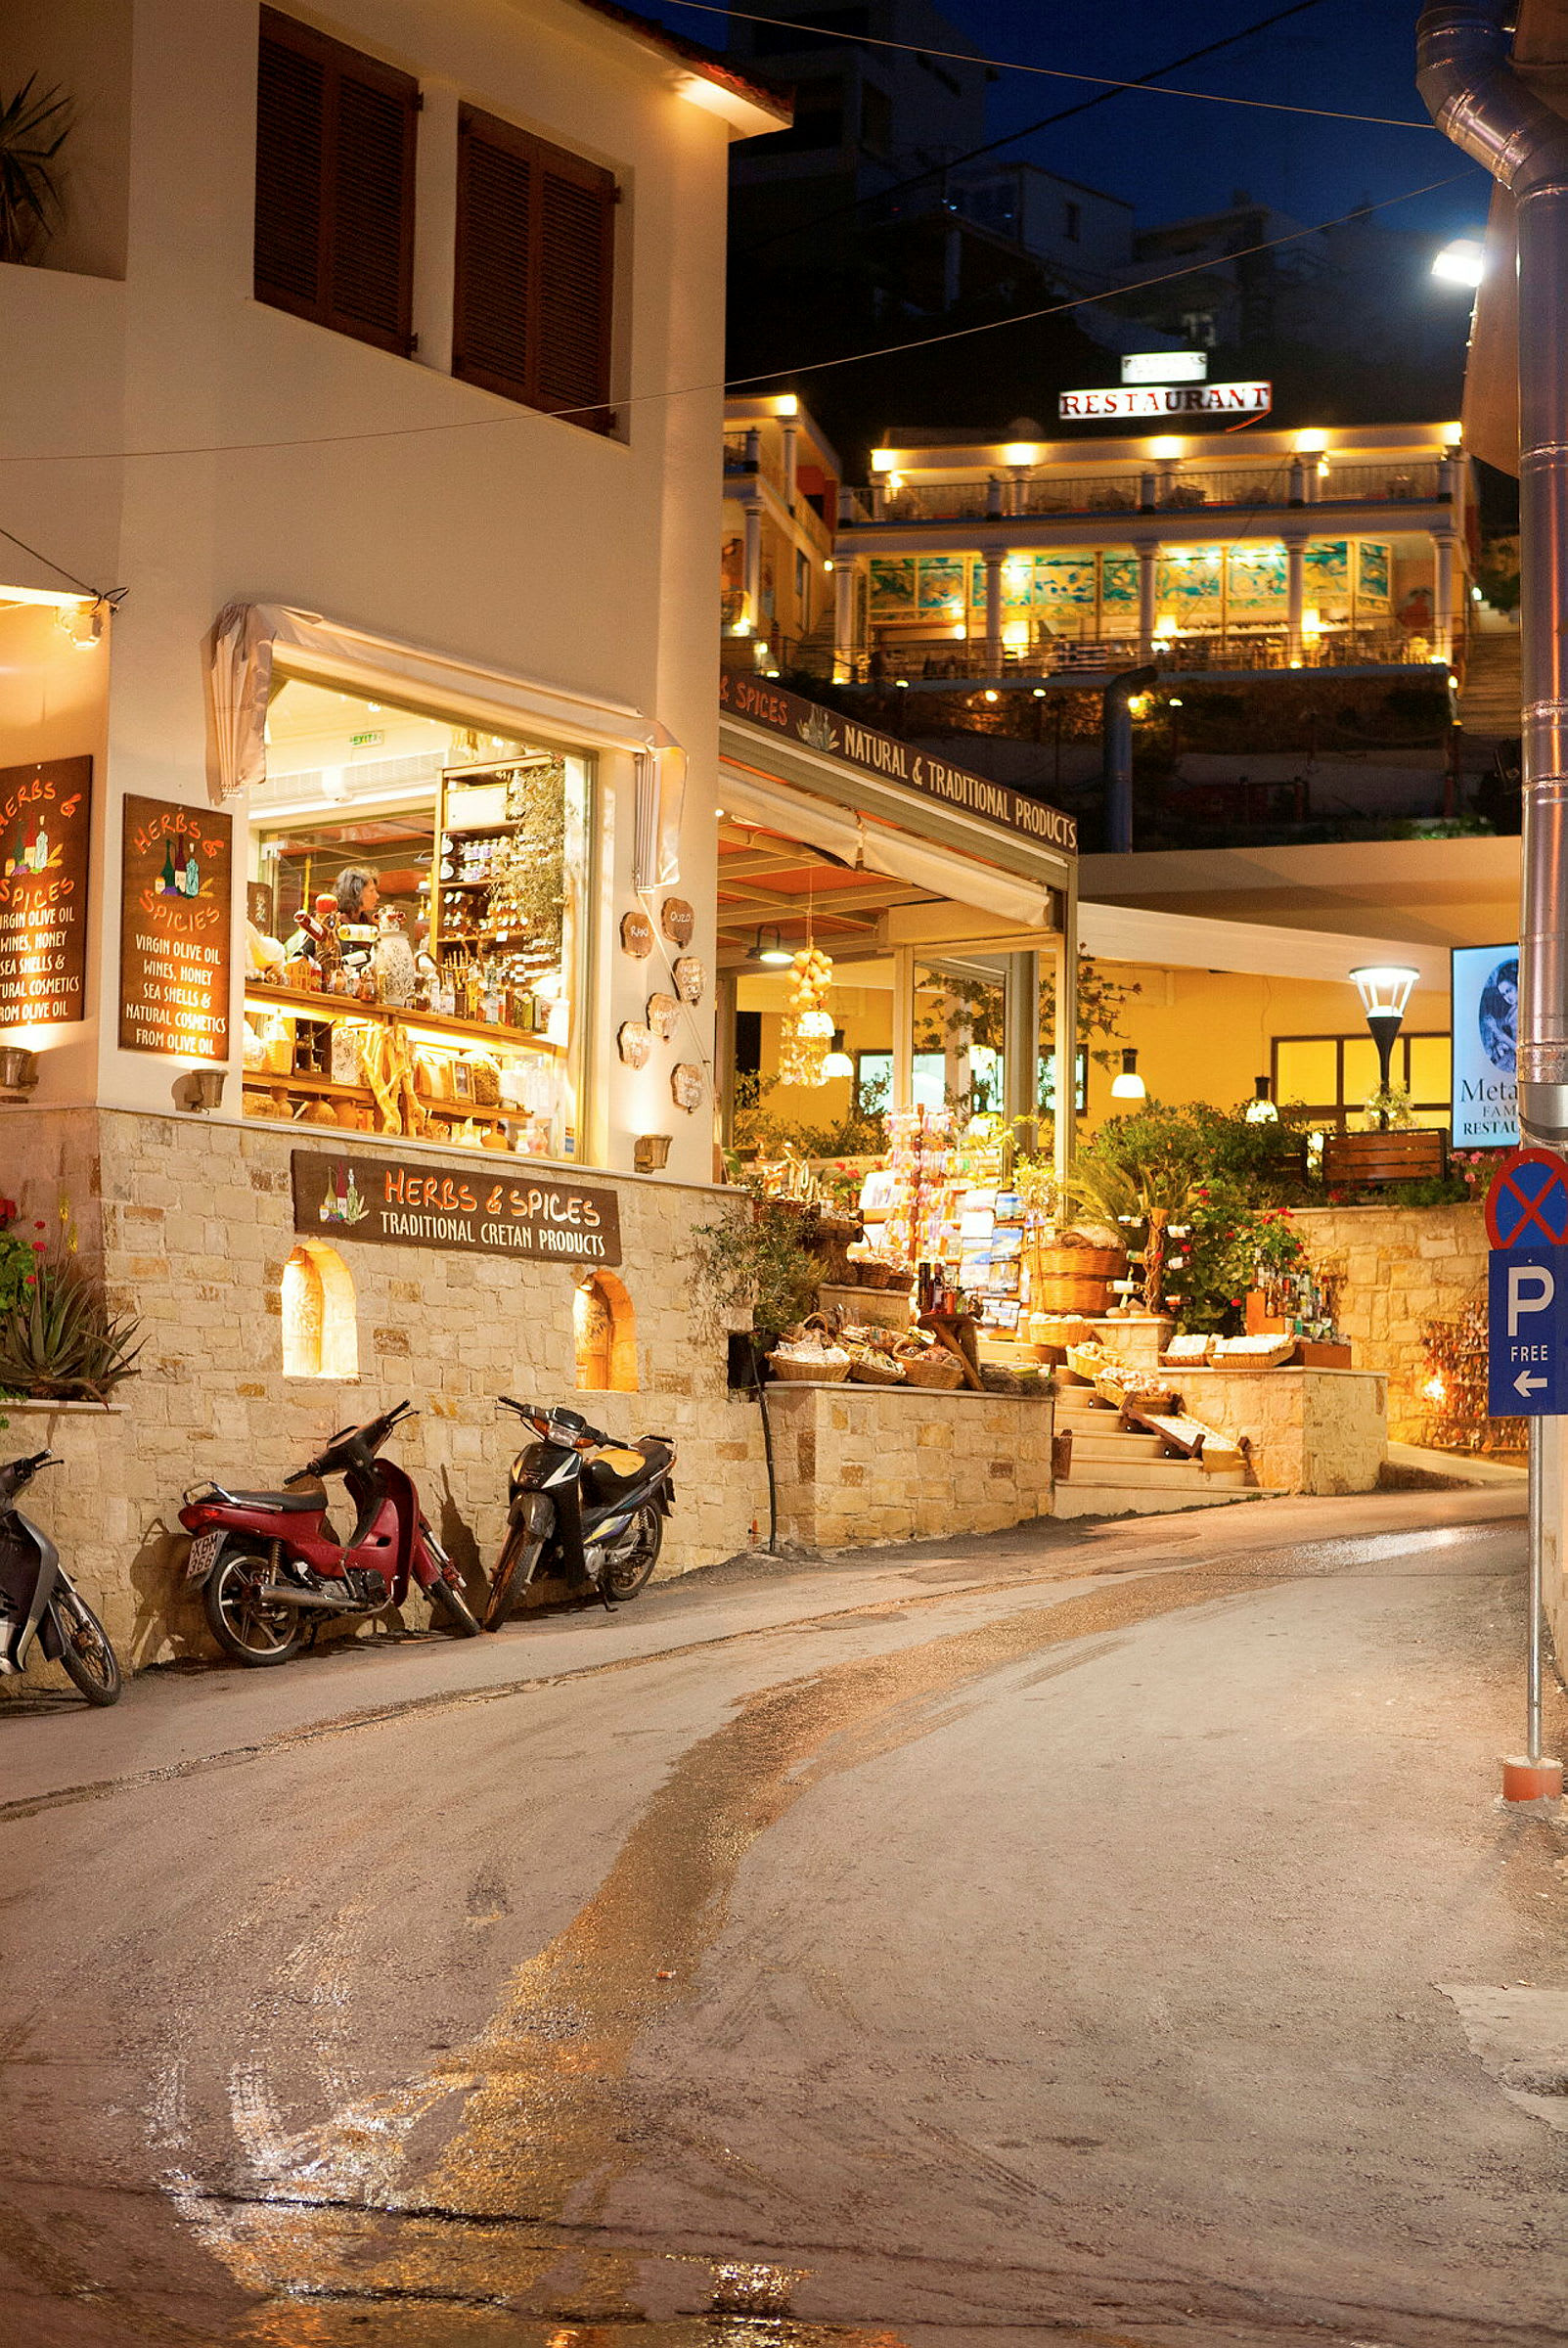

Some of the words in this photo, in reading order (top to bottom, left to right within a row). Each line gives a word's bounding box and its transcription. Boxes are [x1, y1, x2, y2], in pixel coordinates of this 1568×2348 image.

[1060, 388, 1270, 415] RESTAURANT
[736, 682, 787, 726] SPICES
[844, 724, 908, 780] NATURAL
[912, 756, 922, 786] &
[927, 761, 1010, 823] TRADITIONAL
[1015, 798, 1077, 849] PRODUCTS
[134, 813, 202, 855] HERBS
[0, 911, 26, 929] IRGIN
[28, 908, 56, 927] OLIVE
[59, 906, 75, 923] OIL
[34, 930, 67, 950] HONEY
[136, 934, 170, 956] VIRGIN
[173, 941, 202, 962] OLIVE
[204, 947, 221, 965] OIL
[0, 958, 17, 976] SEA
[19, 954, 53, 974] SHELLS
[55, 954, 66, 971] &
[144, 959, 176, 981] WINES,
[180, 966, 213, 986] HONEY
[28, 976, 79, 997] COSMETICS
[144, 982, 161, 1000] SEA
[163, 985, 199, 1008] SHELLS
[201, 993, 211, 1009] &
[0, 1005, 20, 1022] ROM
[22, 1000, 50, 1020] OLIVE
[52, 1000, 68, 1017] OIL
[126, 1003, 172, 1025] NATURAL
[174, 1012, 226, 1033] COSMETICS
[136, 1028, 164, 1048] FROM
[167, 1034, 197, 1053] OLIVE
[198, 1038, 215, 1055] OIL
[1460, 1078, 1517, 1103] Meta
[1483, 1105, 1516, 1117] FAM
[1463, 1120, 1518, 1135] RESTAU
[384, 1168, 478, 1213] HERBS
[485, 1184, 502, 1215] &
[509, 1189, 601, 1227] SPICES
[380, 1211, 475, 1242] TRADITIONAL
[480, 1223, 532, 1248] CRETAN
[539, 1231, 605, 1257] PRODUCTS
[1507, 1265, 1554, 1336] P
[1510, 1344, 1548, 1363] FREE
